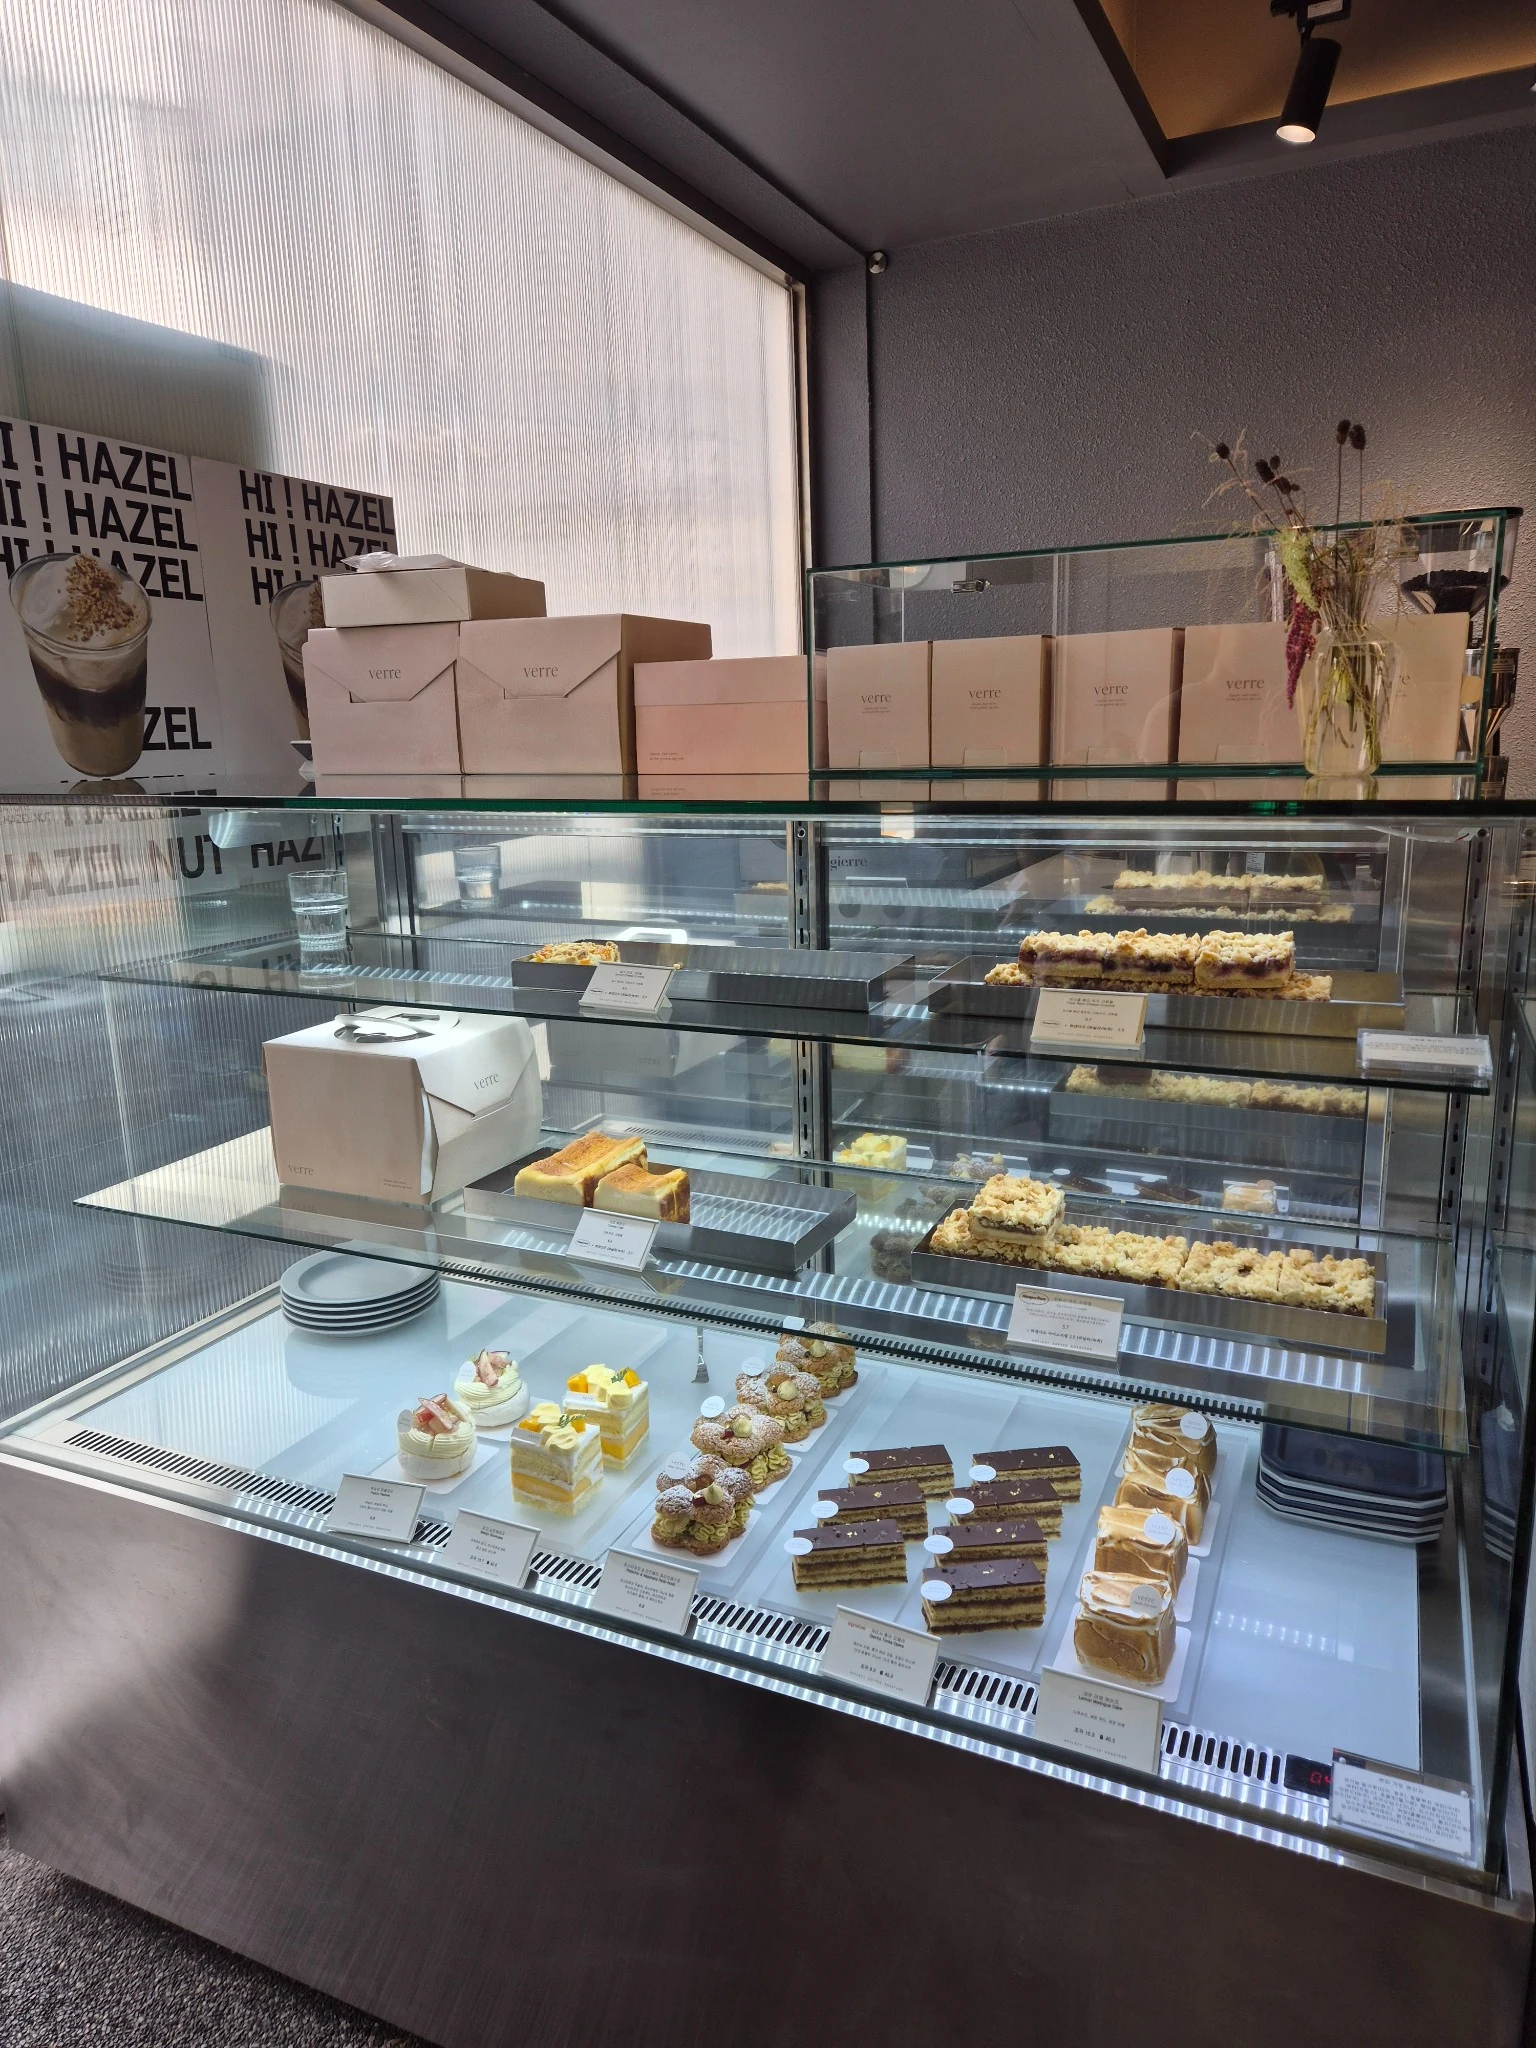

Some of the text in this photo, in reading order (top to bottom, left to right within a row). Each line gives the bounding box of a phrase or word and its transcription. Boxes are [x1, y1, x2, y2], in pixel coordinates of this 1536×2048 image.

[57, 433, 192, 501] HAZEL
[239, 470, 276, 514] HI
[302, 483, 395, 535] HAZEL
[65, 489, 198, 551] HAZEL
[245, 518, 282, 561] HI
[307, 529, 389, 572] HAZ
[368, 668, 402, 680] verre
[523, 665, 559, 678] verre
[1094, 683, 1128, 696] verre
[1226, 676, 1265, 690] verre
[861, 692, 891, 704] verre
[968, 687, 1002, 699] verre
[149, 834, 222, 884] NUT
[251, 836, 325, 868] HAZ
[473, 1072, 499, 1091] verre
[288, 1164, 314, 1176] verre
[847, 1620, 866, 1631] signature
